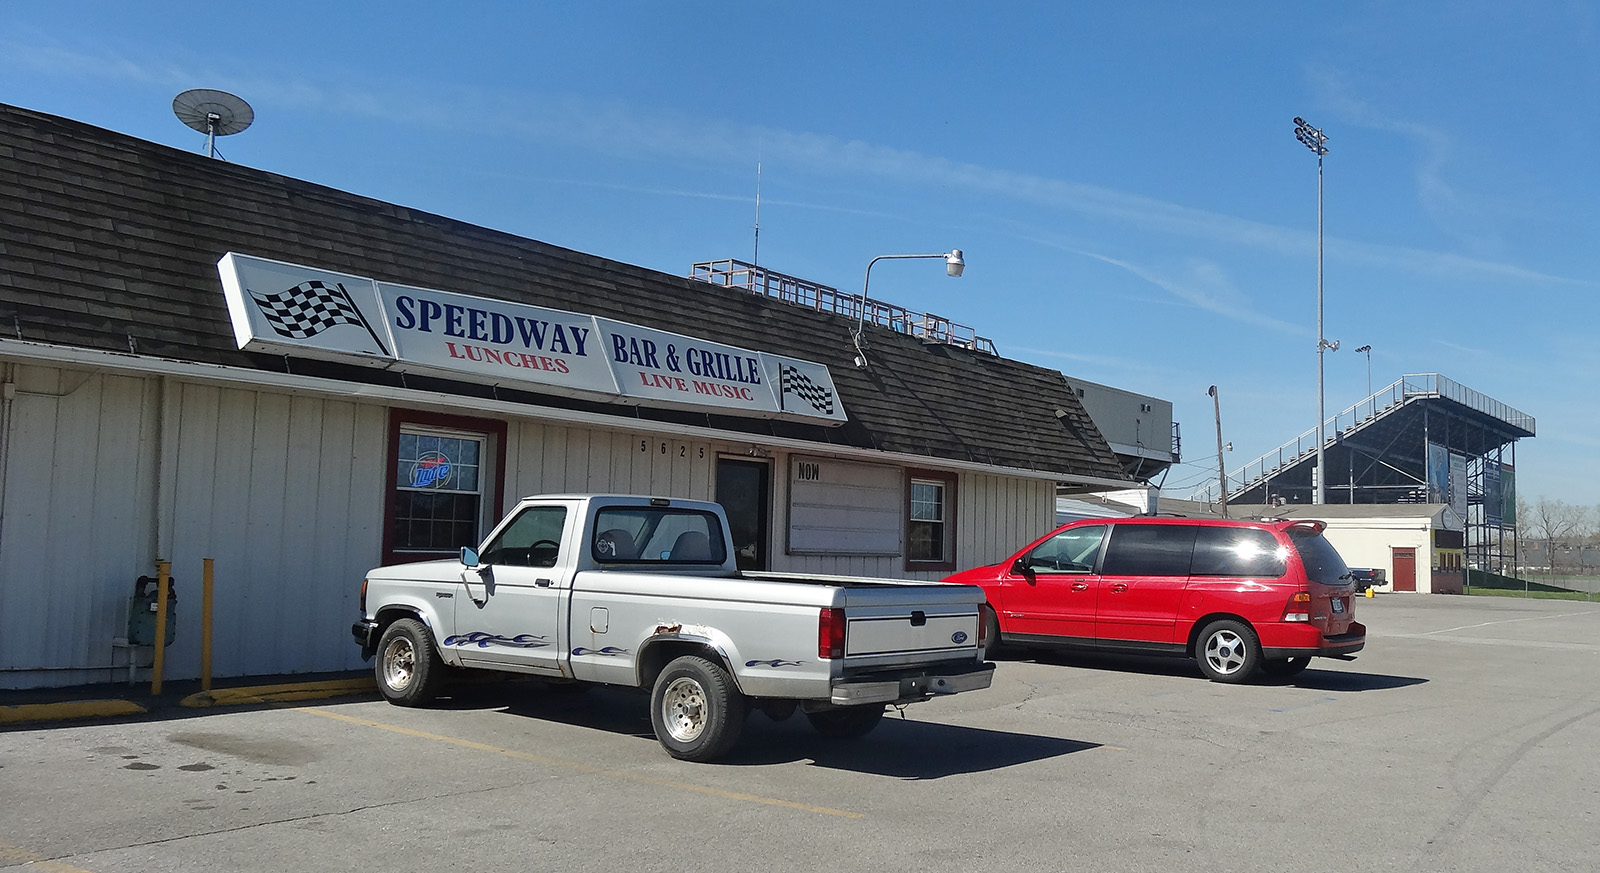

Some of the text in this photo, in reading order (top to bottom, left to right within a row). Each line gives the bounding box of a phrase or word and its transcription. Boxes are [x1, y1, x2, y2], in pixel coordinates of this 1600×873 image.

[395, 295, 762, 385] SPEEDWAY BAR & GRILLE
[445, 342, 571, 374] LUNCHES
[638, 371, 754, 402] LIVE MUSIC
[641, 440, 704, 459] 5625
[798, 462, 820, 481] NOW
